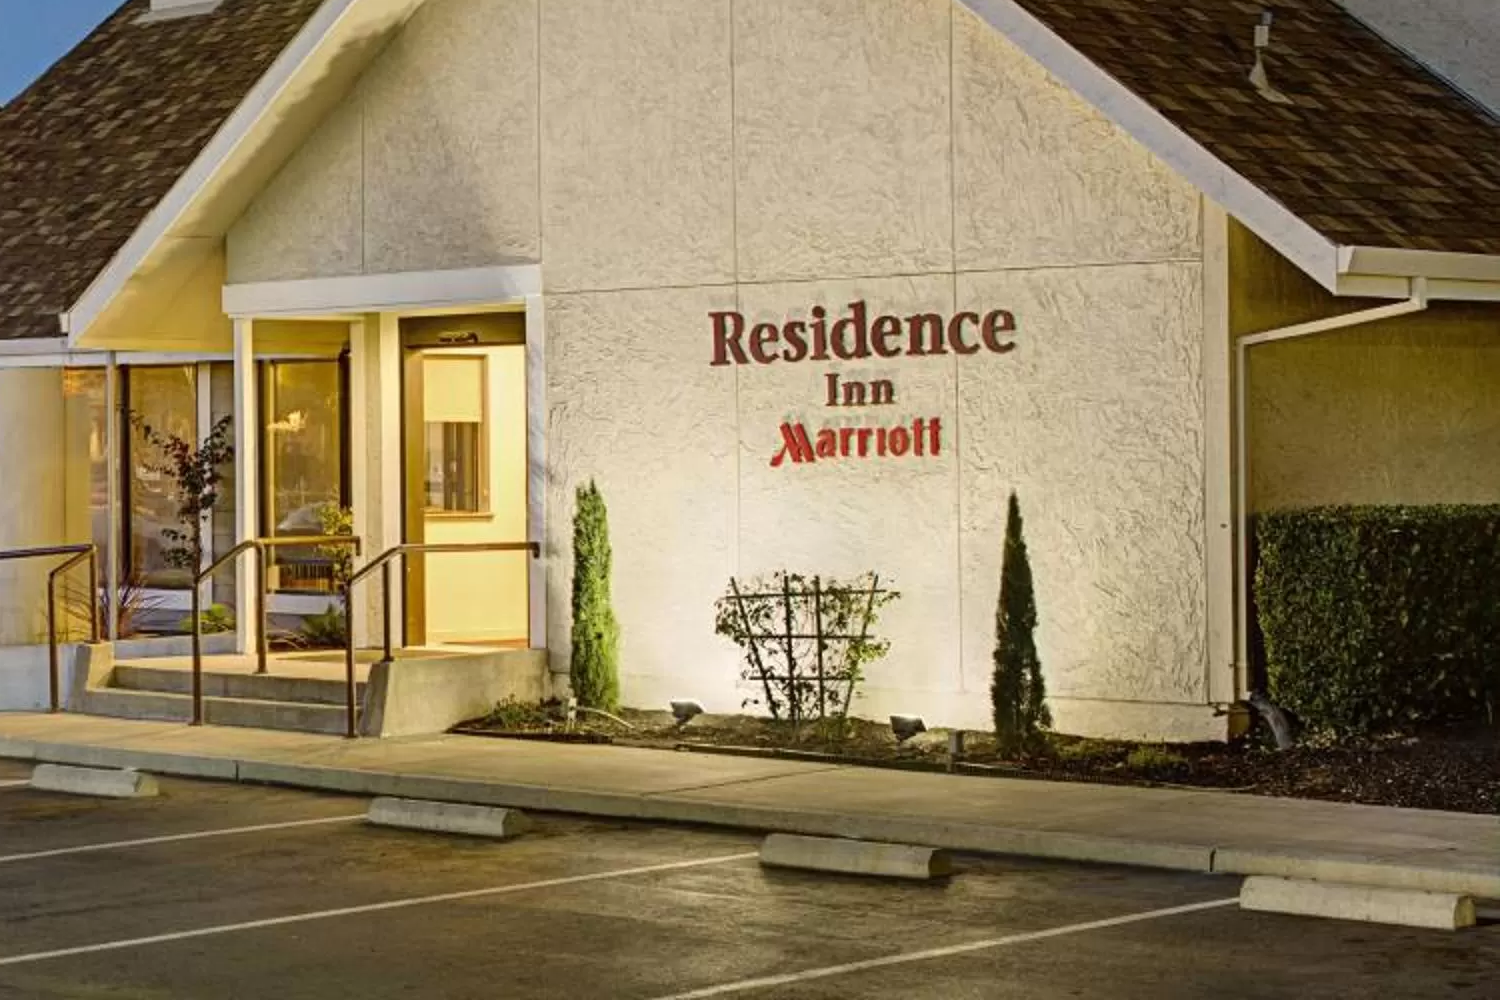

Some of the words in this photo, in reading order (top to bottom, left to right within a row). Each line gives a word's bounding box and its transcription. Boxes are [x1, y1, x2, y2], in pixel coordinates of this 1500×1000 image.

[708, 300, 1017, 366] Residence
[824, 373, 896, 406] Inn
[769, 417, 942, 467] Marriott
